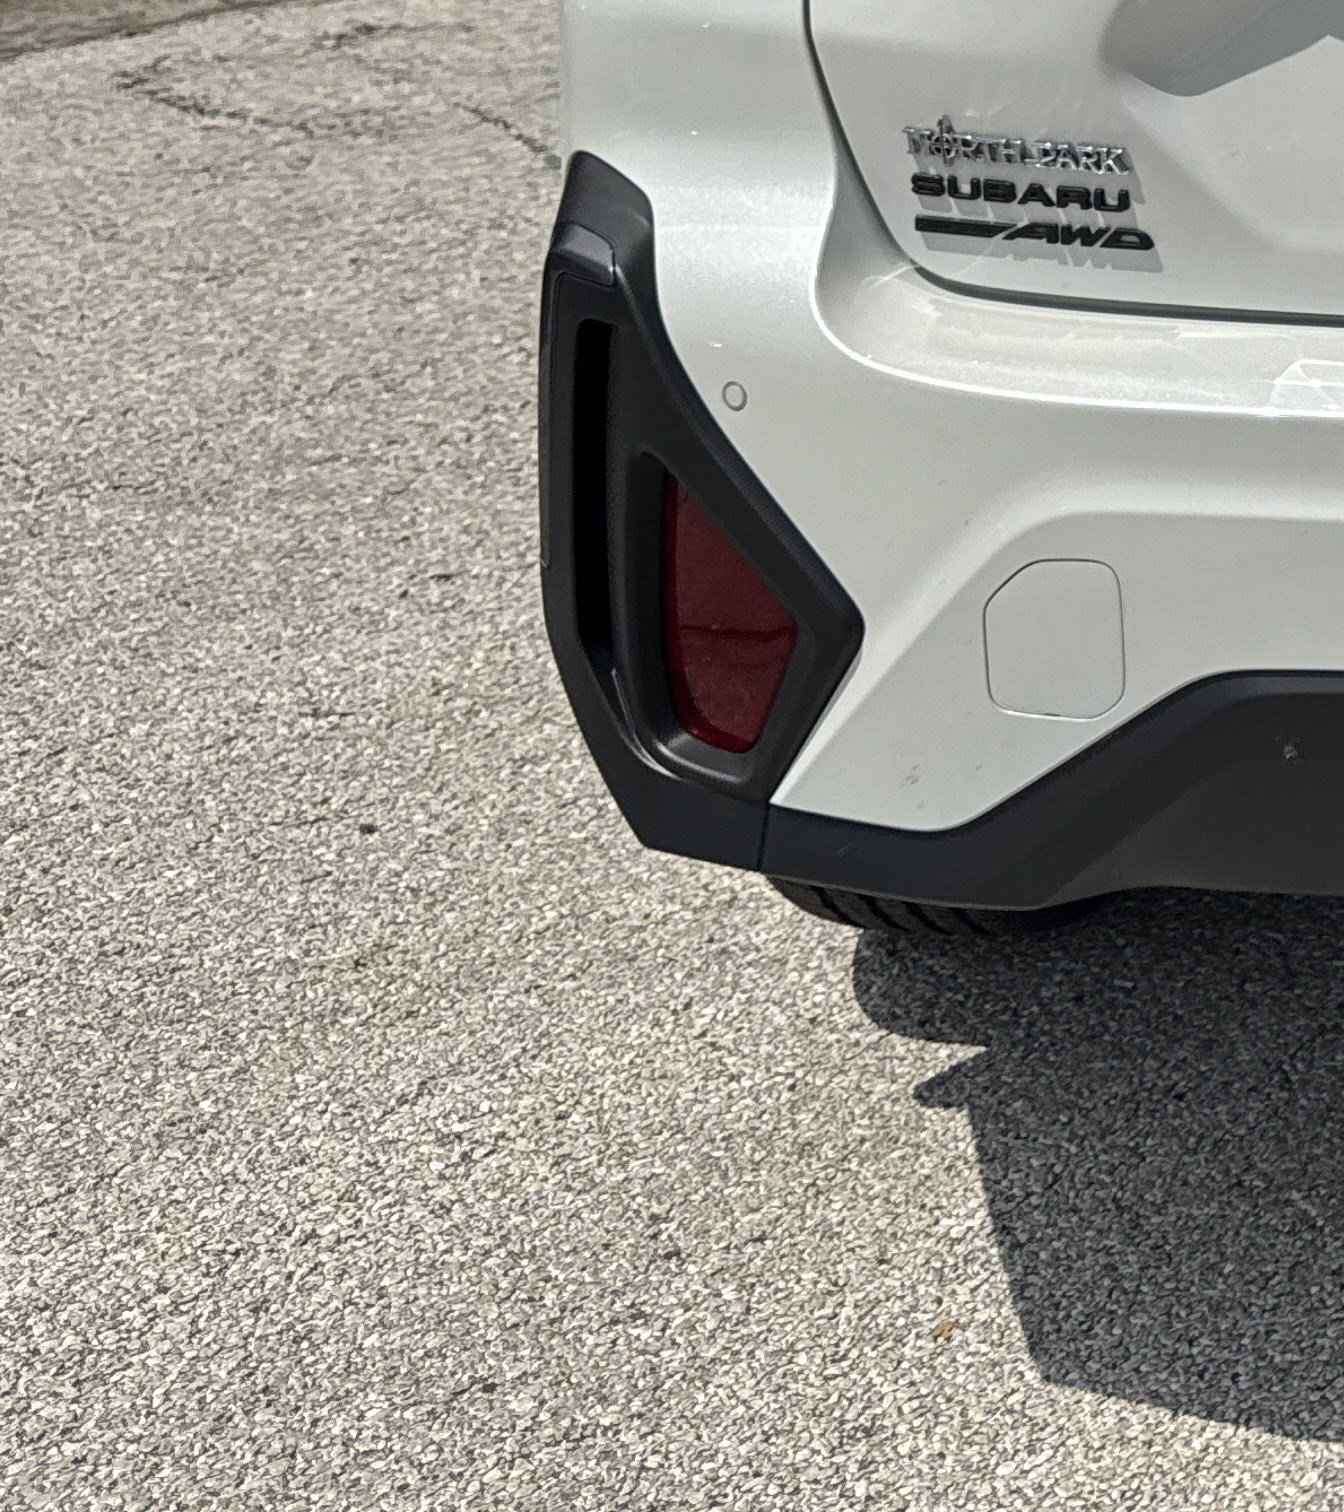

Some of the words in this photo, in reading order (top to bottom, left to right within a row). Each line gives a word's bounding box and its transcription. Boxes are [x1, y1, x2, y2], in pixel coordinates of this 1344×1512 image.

[1024, 140, 1131, 176] PARK
[911, 172, 1131, 212] SUBARU
[1002, 221, 1156, 251] AWD
